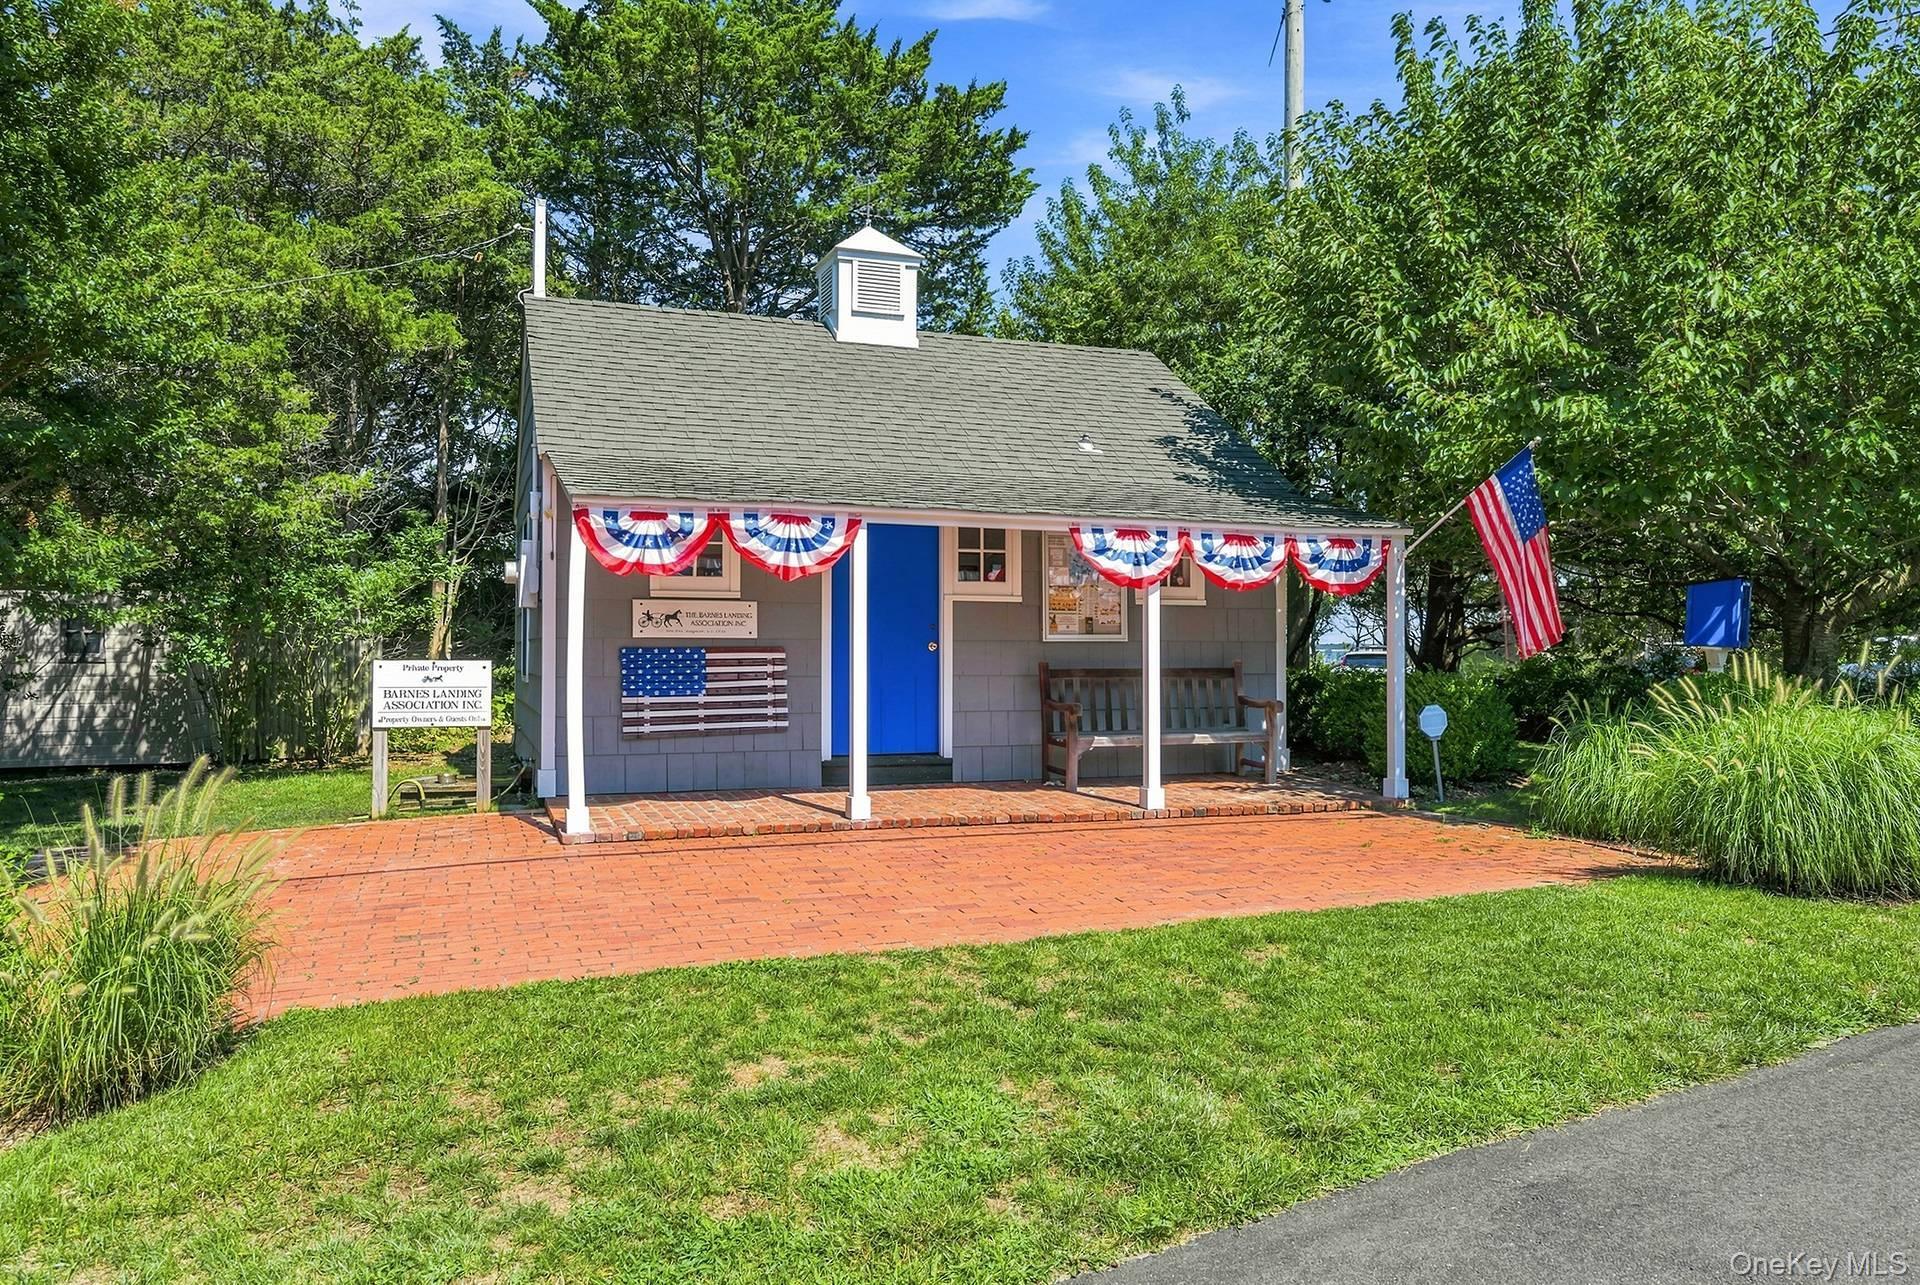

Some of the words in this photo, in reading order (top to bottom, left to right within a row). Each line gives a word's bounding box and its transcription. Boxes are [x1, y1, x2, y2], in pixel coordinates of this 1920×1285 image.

[402, 664, 430, 672] Private
[431, 664, 464, 673] Property
[383, 689, 430, 699] BARNES
[432, 689, 482, 699] LANDING
[383, 700, 459, 710] ASSOCIATION
[380, 716, 409, 725] Property
[411, 715, 437, 723] Owners
[438, 715, 444, 723] &
[445, 715, 467, 723] Guests
